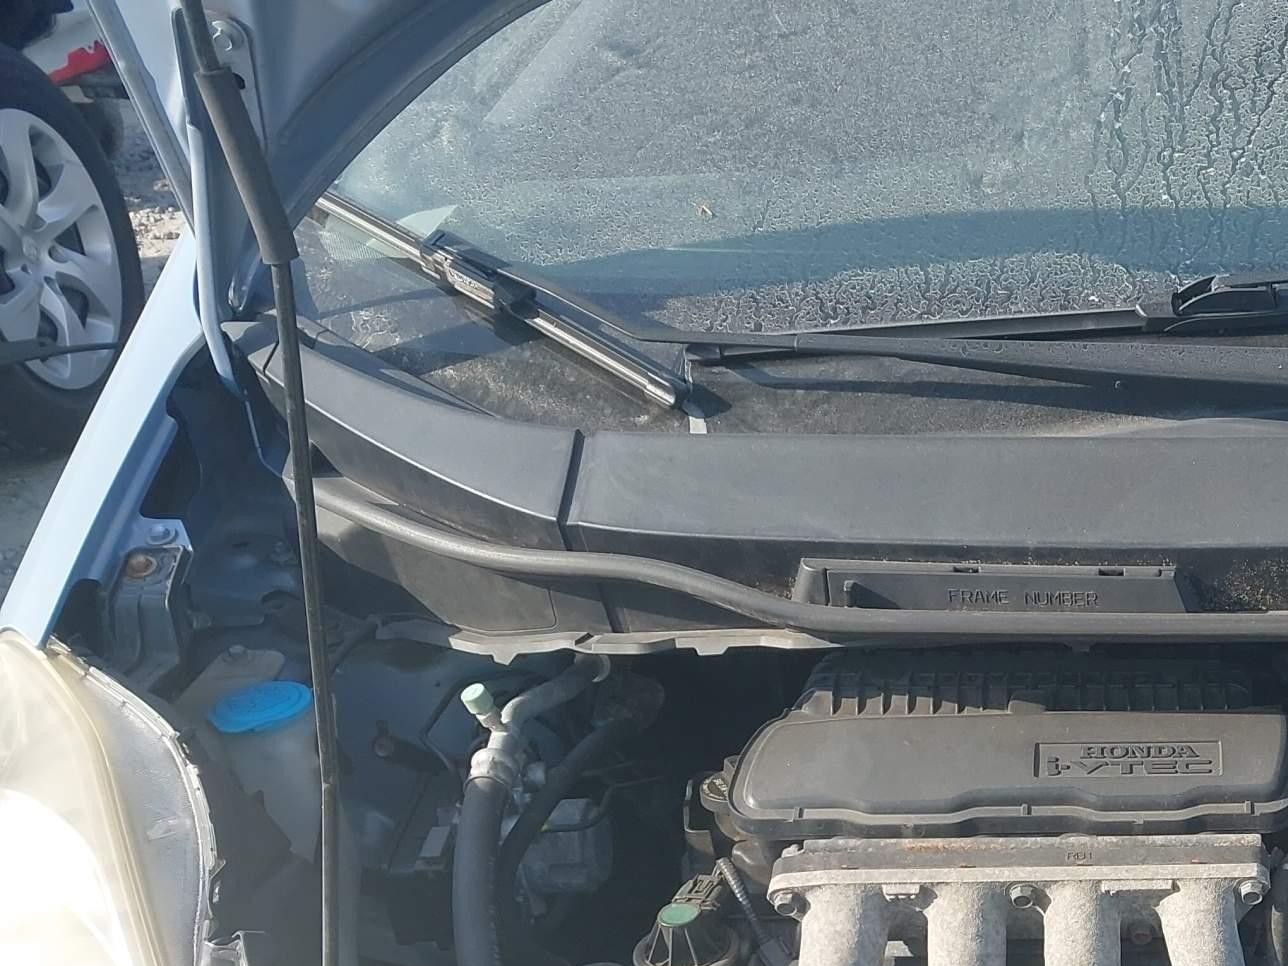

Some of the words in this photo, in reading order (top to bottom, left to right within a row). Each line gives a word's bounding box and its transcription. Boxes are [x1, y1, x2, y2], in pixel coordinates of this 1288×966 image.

[948, 588, 1009, 605] FRAME
[1024, 590, 1099, 608] NUMBER
[1080, 744, 1200, 759] HONDA
